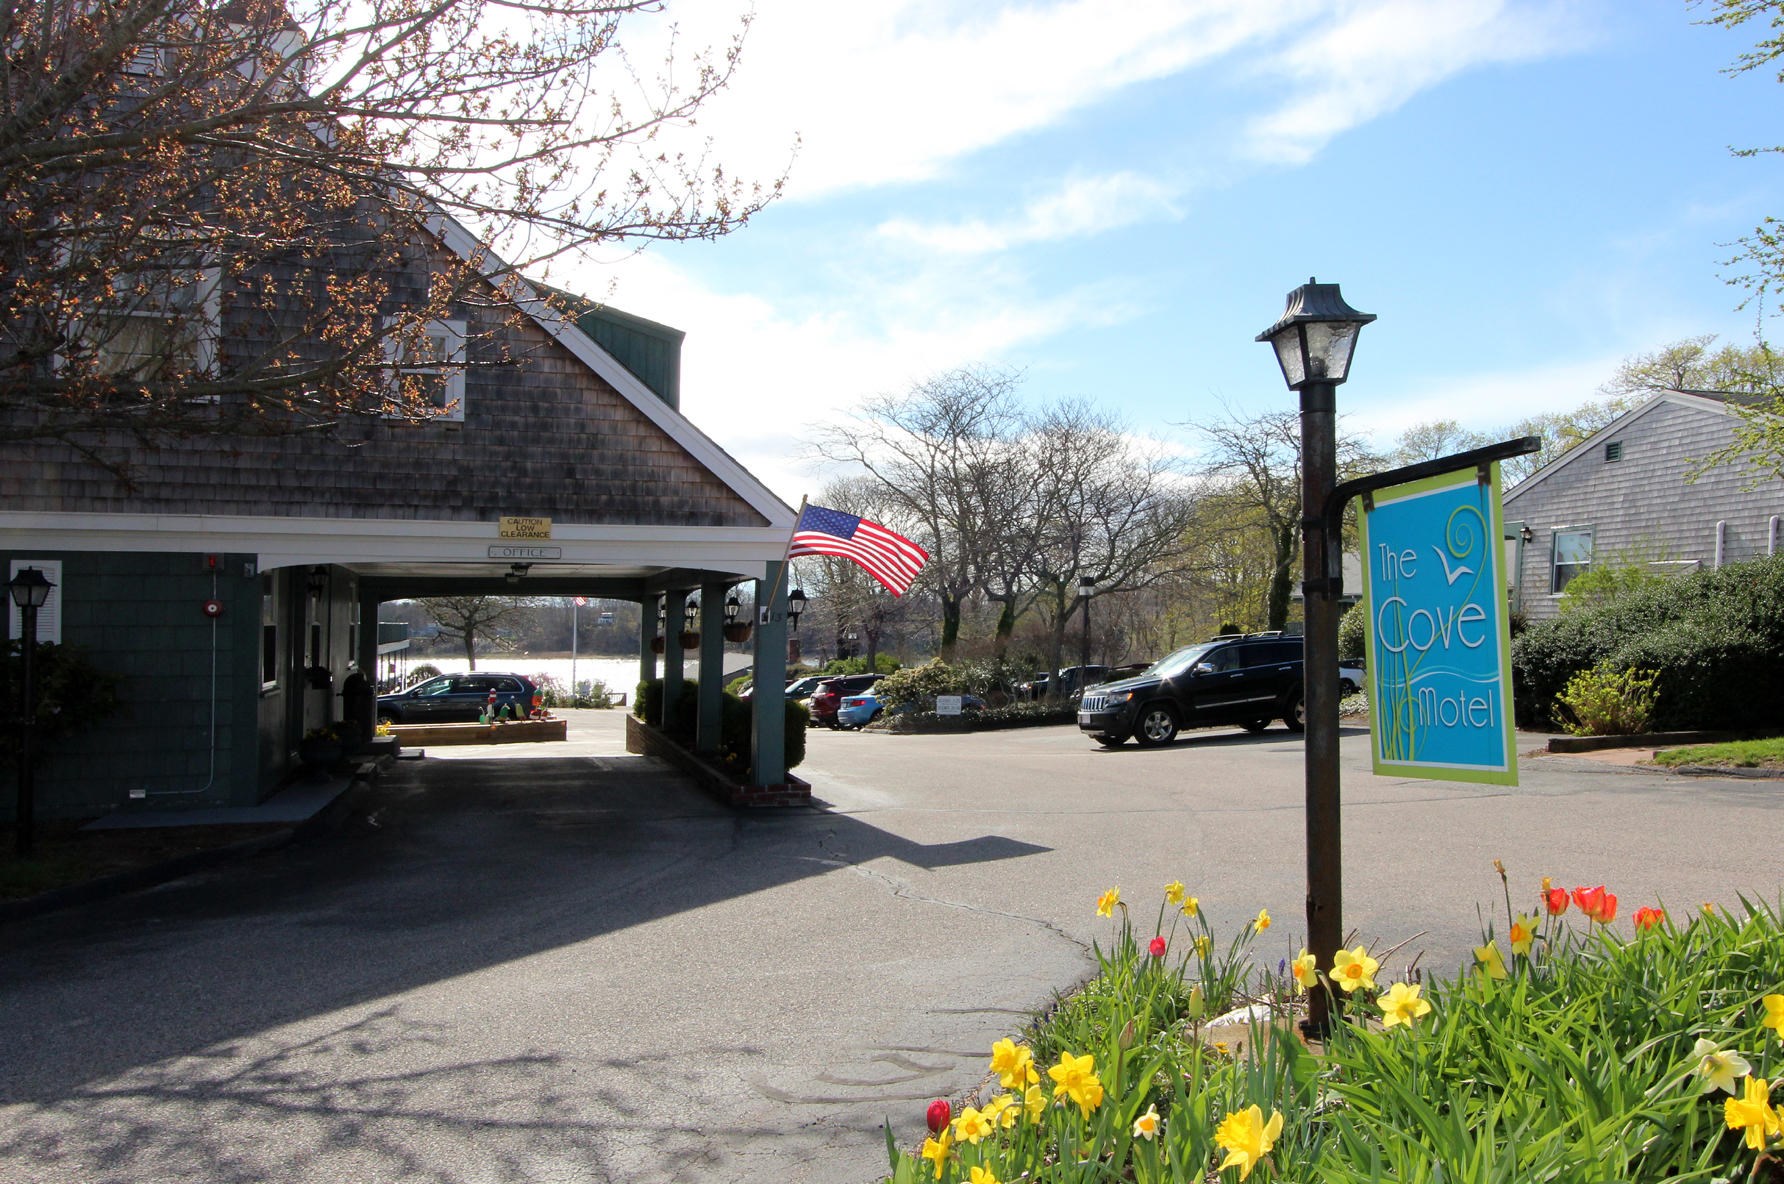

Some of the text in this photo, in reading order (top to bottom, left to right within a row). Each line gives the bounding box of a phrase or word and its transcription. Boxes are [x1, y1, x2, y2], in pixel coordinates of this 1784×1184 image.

[503, 548, 547, 557] OFFICE
[1378, 543, 1417, 581] The
[1378, 596, 1487, 652] Cove
